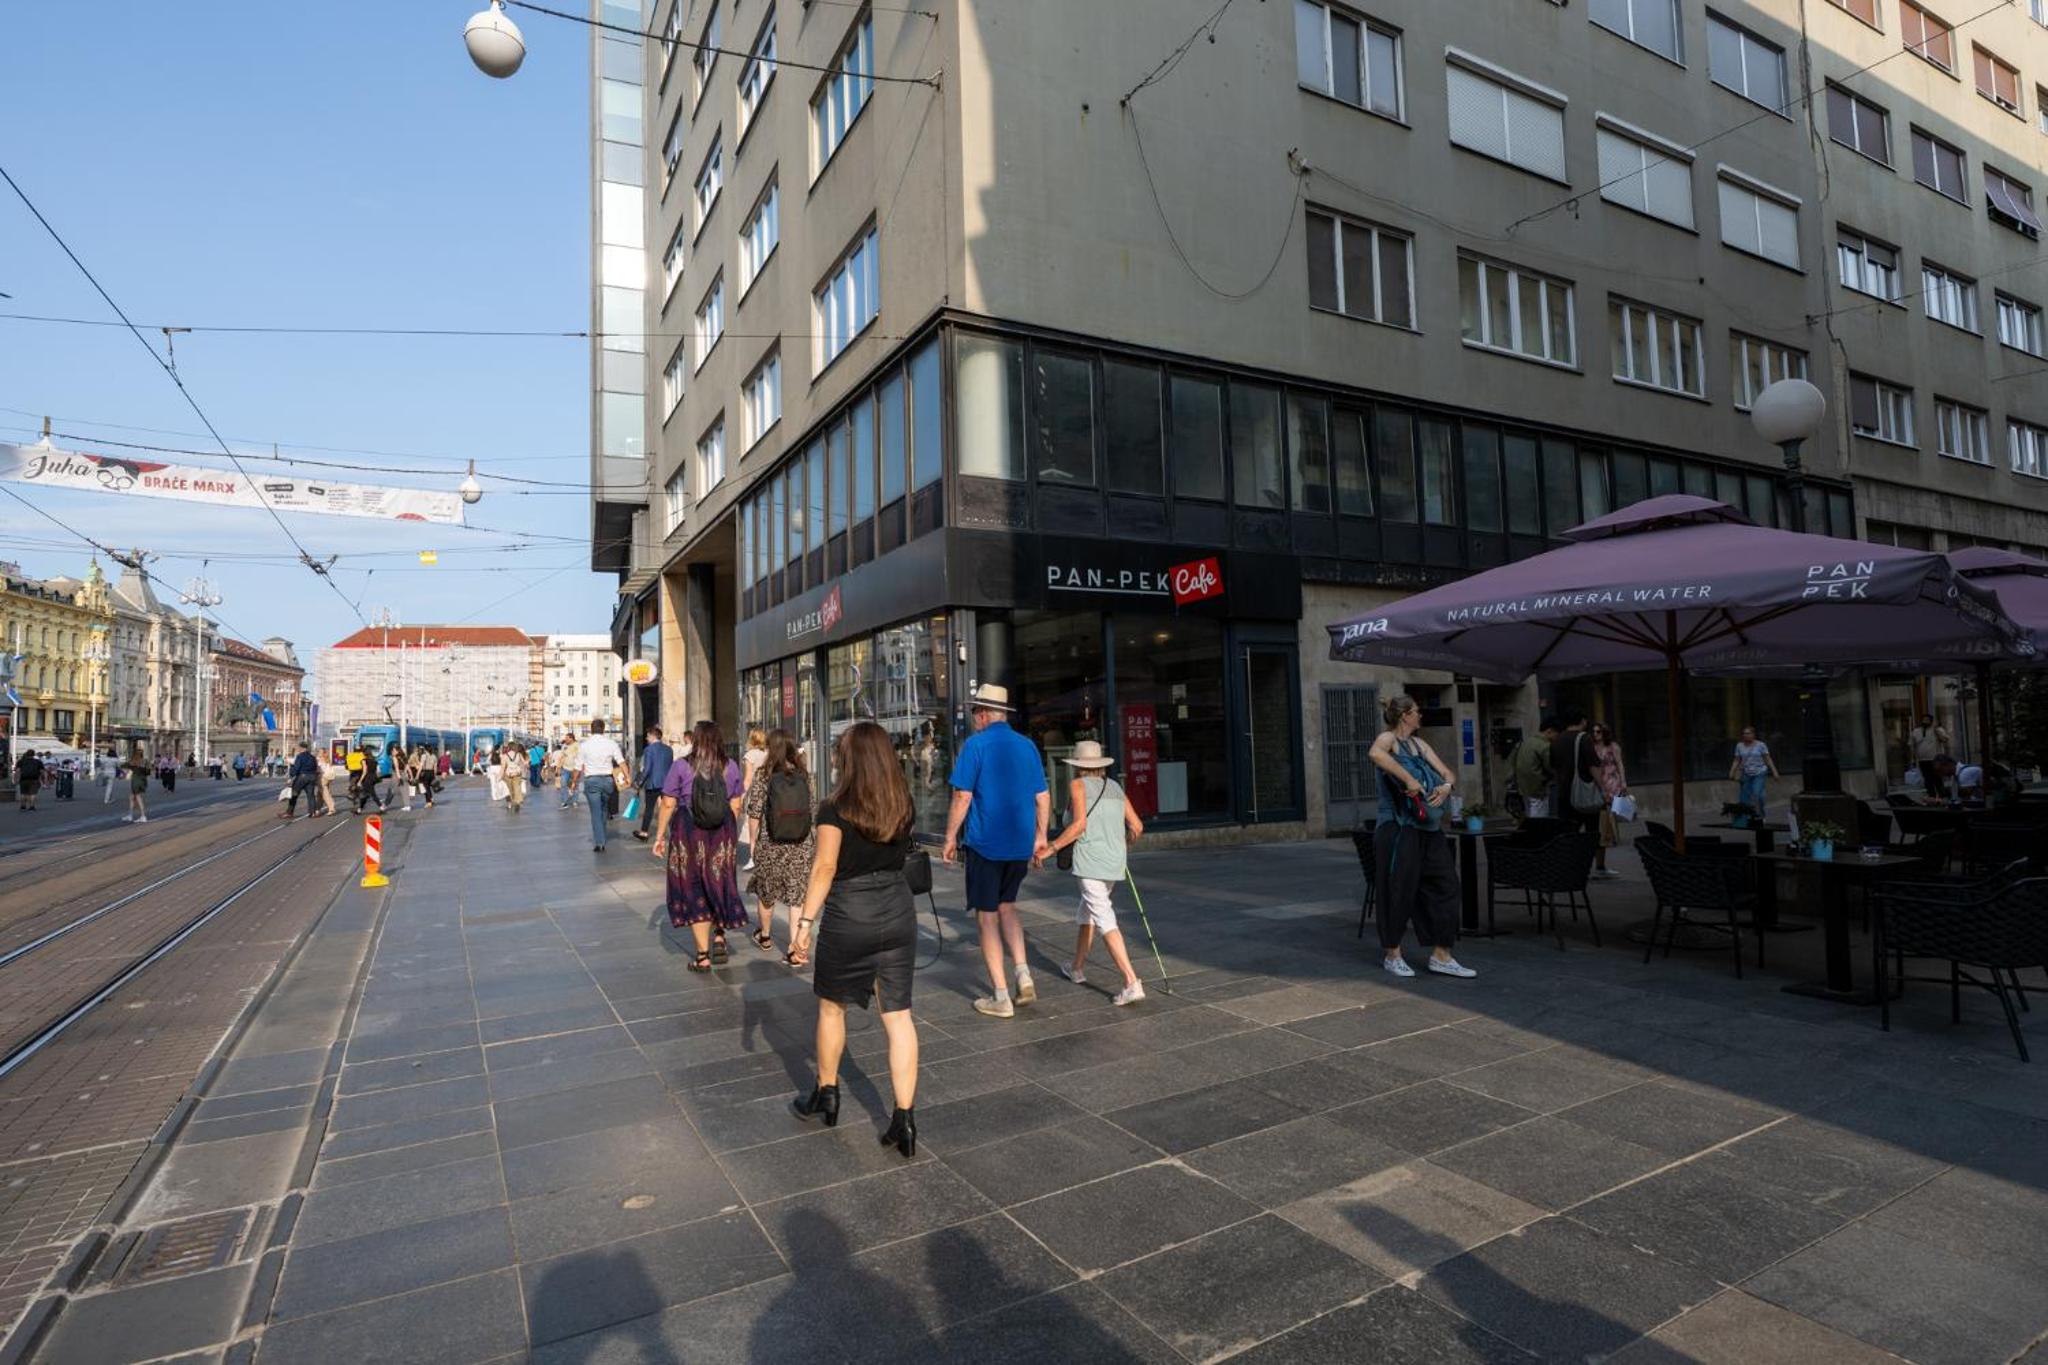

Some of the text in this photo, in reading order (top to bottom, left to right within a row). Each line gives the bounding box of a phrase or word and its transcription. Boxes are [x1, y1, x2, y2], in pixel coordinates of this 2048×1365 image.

[24, 455, 92, 479] Juha
[193, 479, 236, 494] MARX
[1047, 563, 1217, 596] PAN-PEK Cafe
[1806, 560, 1875, 578] PAN
[1802, 581, 1871, 598] PEK
[1447, 585, 1712, 622] NATURAL MINERAL WATER
